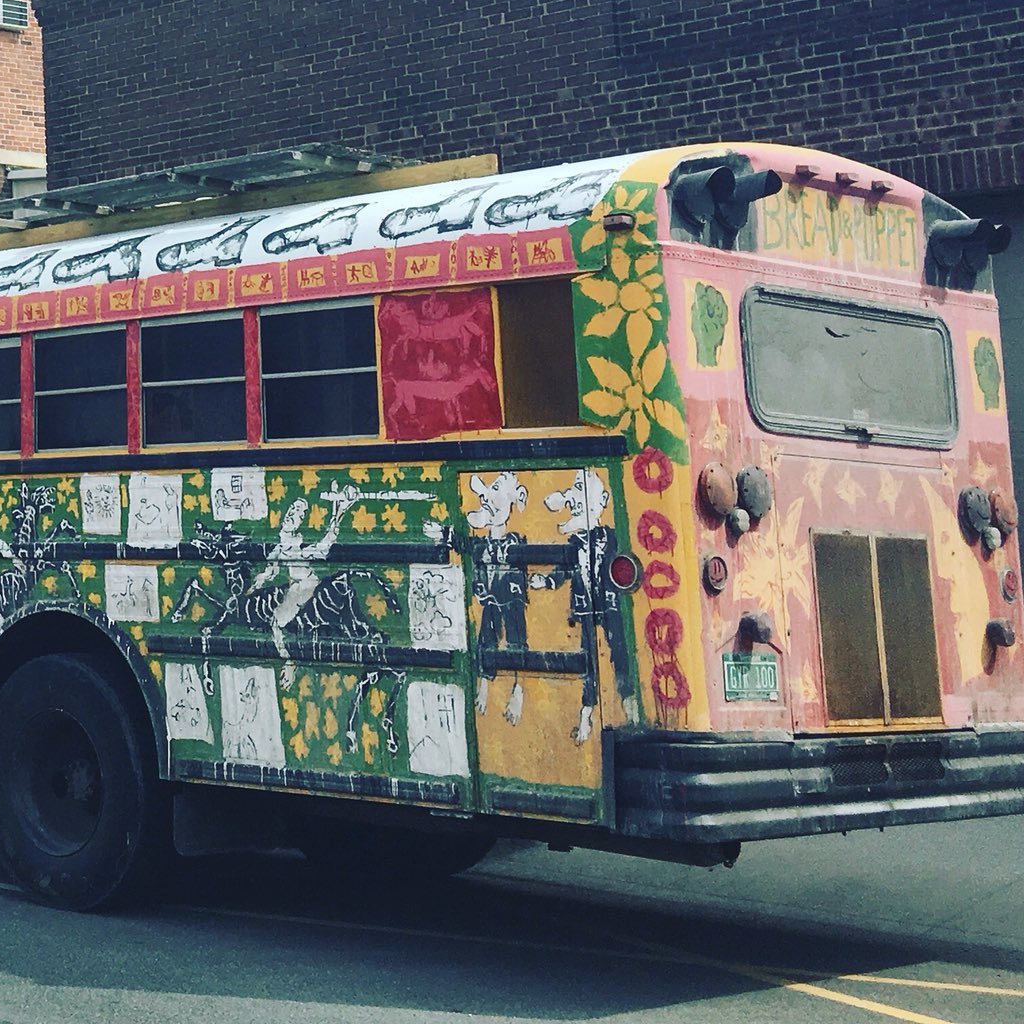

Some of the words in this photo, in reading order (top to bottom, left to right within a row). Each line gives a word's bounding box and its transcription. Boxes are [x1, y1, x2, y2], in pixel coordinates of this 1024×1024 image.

[761, 189, 842, 256] BREAD
[842, 210, 854, 240] &
[853, 202, 918, 270] PUPPET
[755, 666, 775, 689] 100
